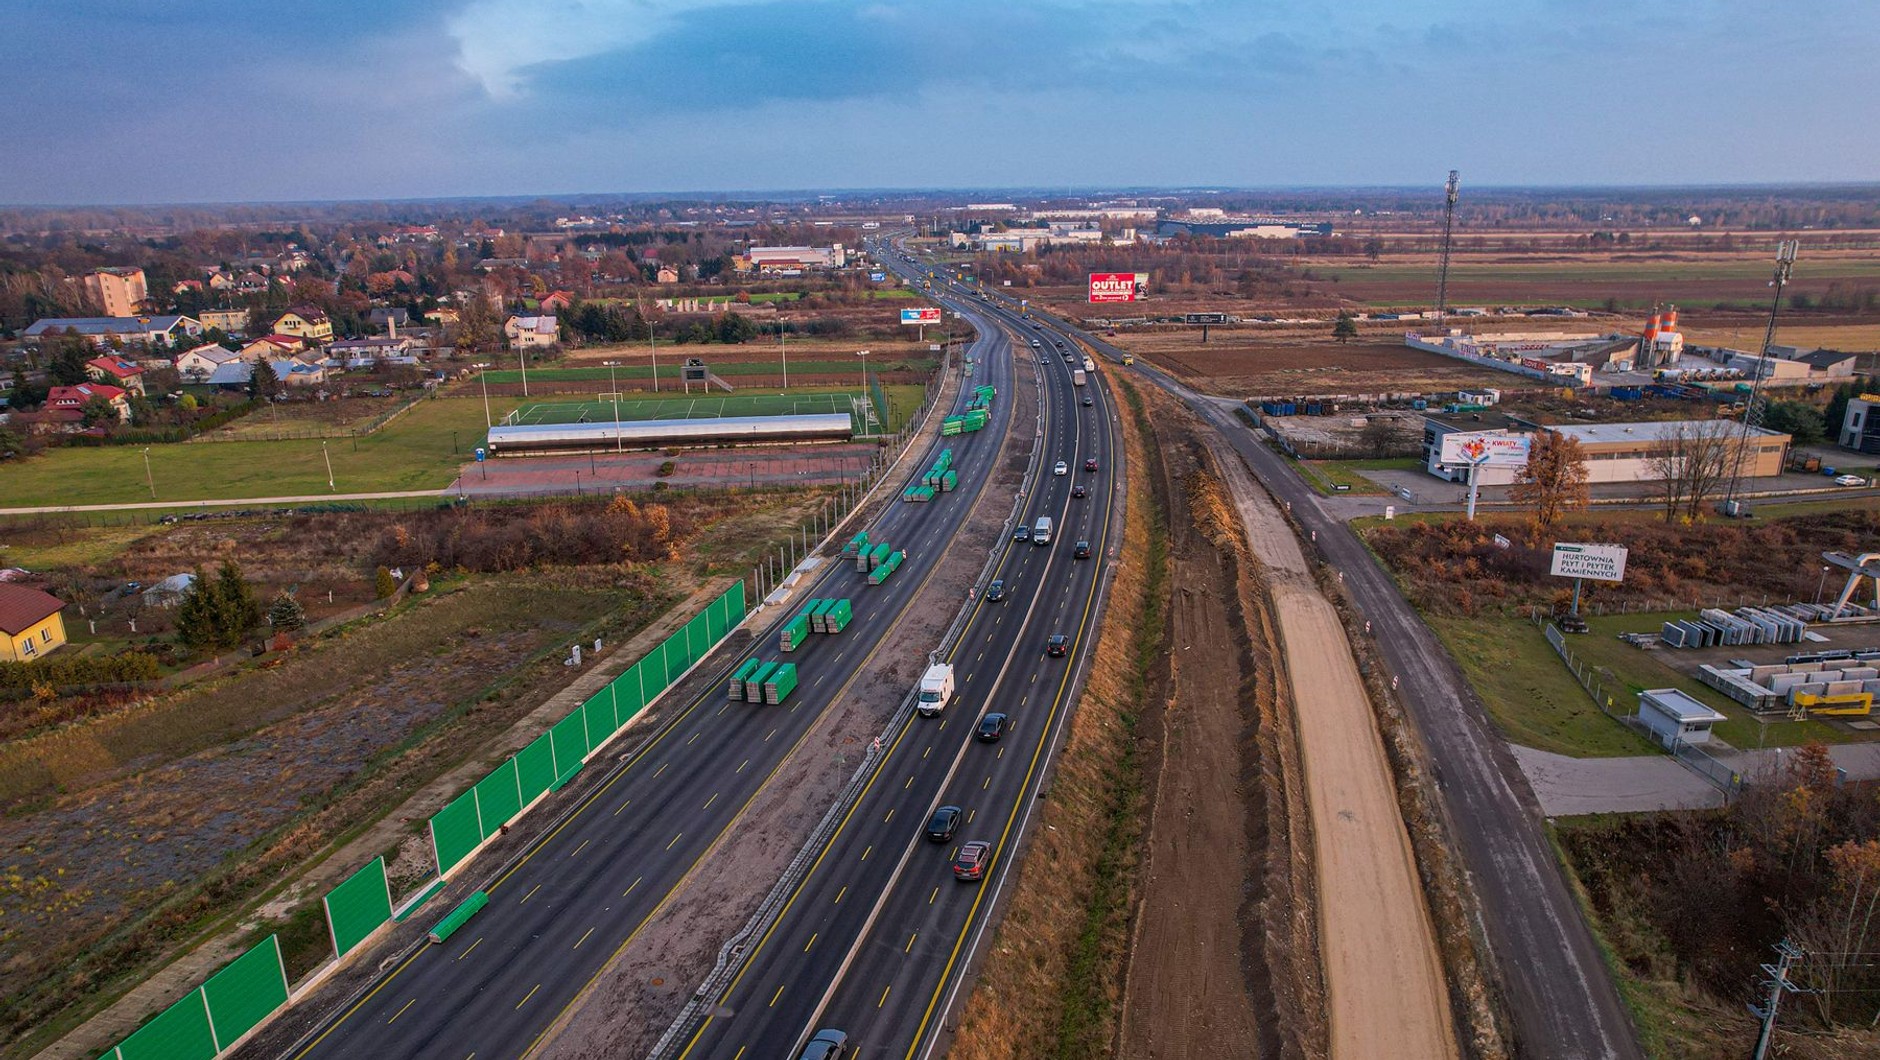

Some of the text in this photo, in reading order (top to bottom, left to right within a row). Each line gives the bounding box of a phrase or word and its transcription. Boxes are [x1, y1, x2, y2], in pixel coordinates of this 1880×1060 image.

[1092, 281, 1133, 290] OUTLET
[1562, 553, 1614, 564] HURTOWNIA
[1561, 560, 1579, 568] PŁYT
[1586, 562, 1615, 571] PŁYTEK
[1561, 567, 1617, 578] KAMIENNYCH
